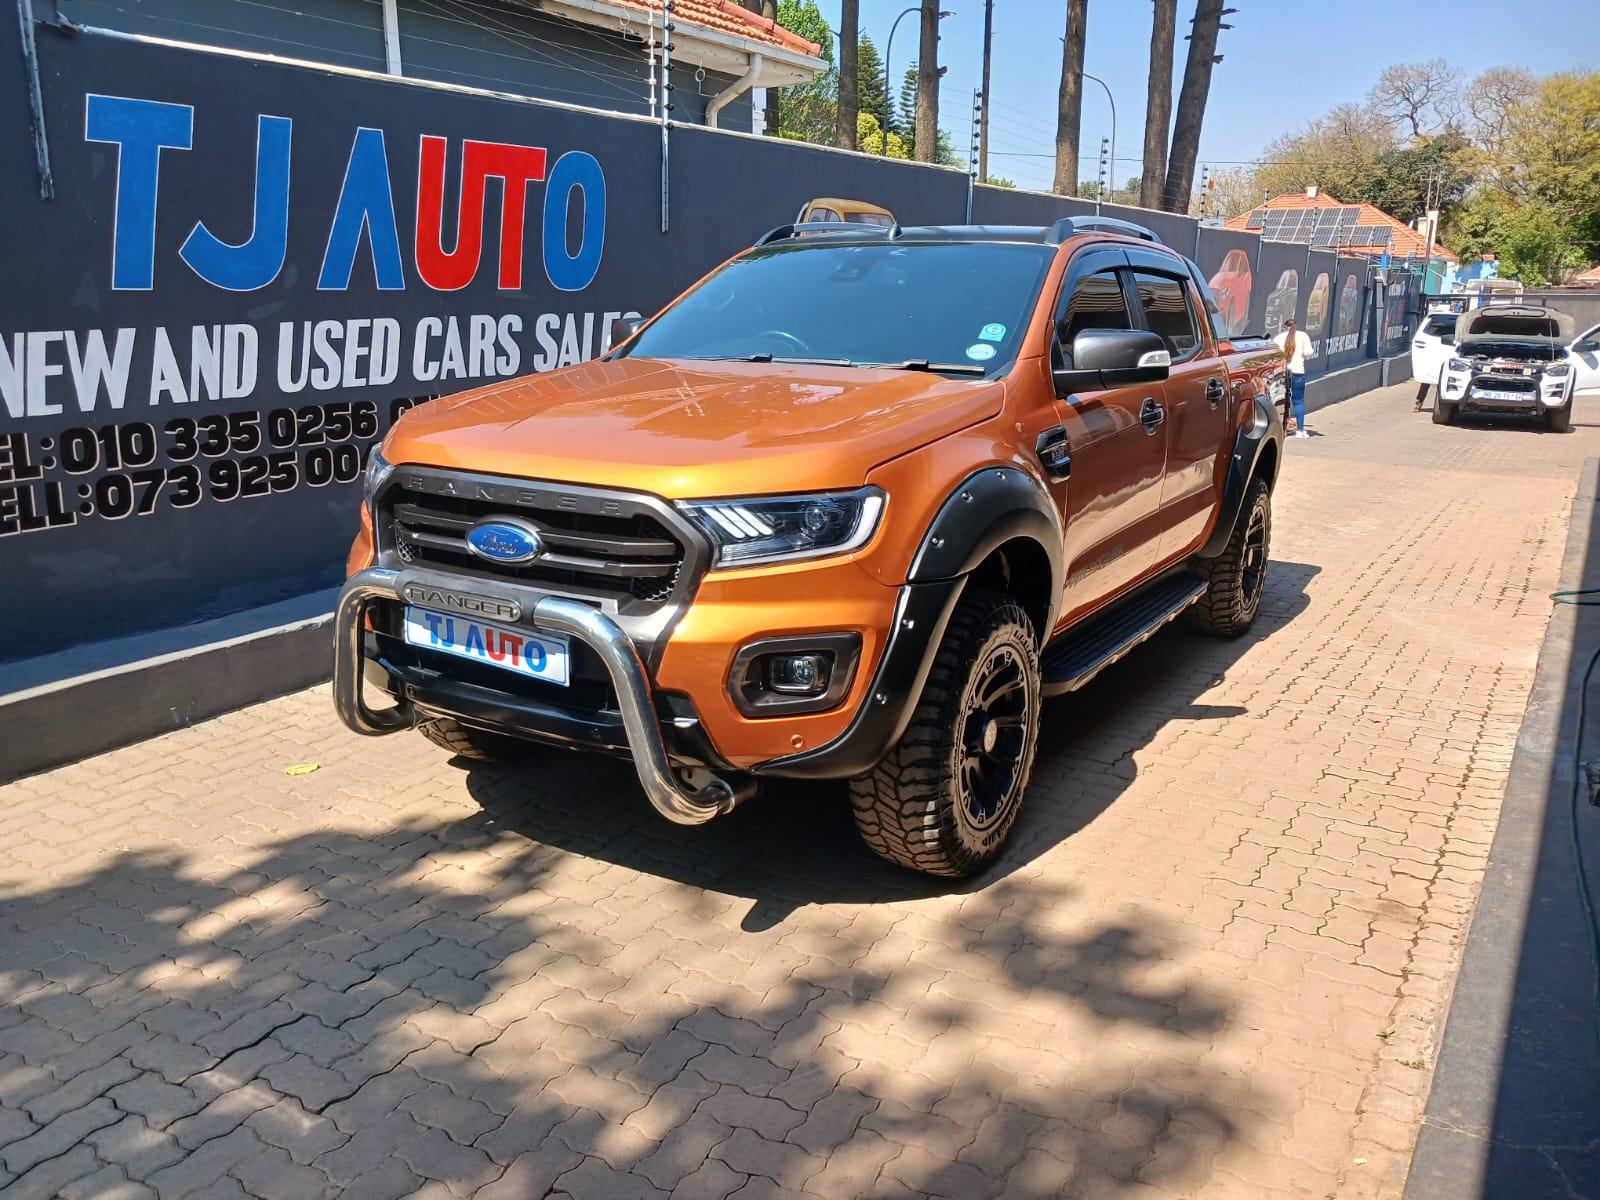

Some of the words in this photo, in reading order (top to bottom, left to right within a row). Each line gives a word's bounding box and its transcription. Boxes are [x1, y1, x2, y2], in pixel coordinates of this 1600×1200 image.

[84, 92, 292, 291] TJ
[317, 127, 607, 292] AUTO
[0, 327, 137, 418] NEW
[149, 323, 259, 405] AND
[277, 316, 401, 394] USED
[411, 314, 523, 382] CARS
[165, 411, 261, 462] 335
[268, 400, 379, 451] 0256
[210, 454, 301, 503] 925
[407, 474, 623, 516] RANGER
[408, 586, 516, 618] RANGER
[424, 613, 456, 647] TJ
[465, 624, 548, 673] AUTO
